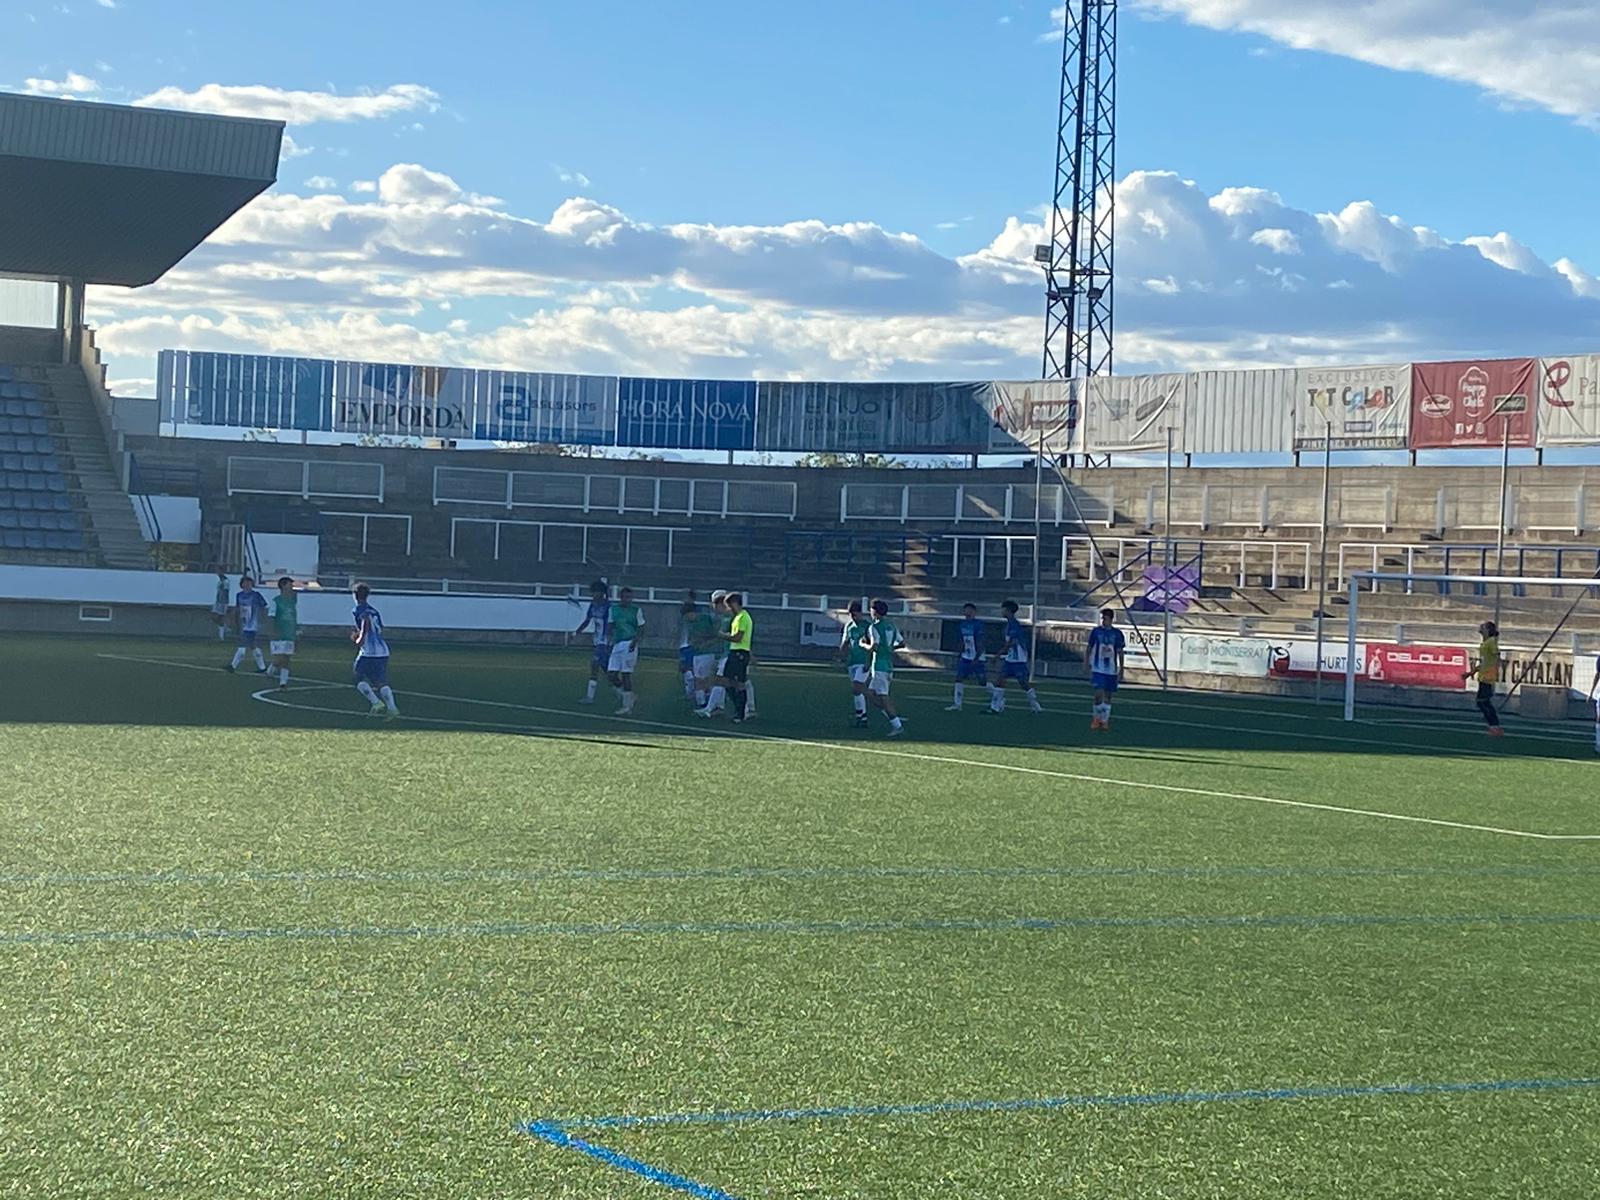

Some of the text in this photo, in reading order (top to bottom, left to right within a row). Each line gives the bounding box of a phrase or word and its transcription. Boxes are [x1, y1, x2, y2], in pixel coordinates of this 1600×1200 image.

[1307, 370, 1397, 384] EXCLUSIVES
[339, 401, 471, 430] EMPORDÀ
[621, 399, 751, 421] HORA NOVA
[1129, 632, 1162, 648] ROGER
[1318, 655, 1362, 671] HURTS
[1511, 660, 1574, 688] CATALAN
